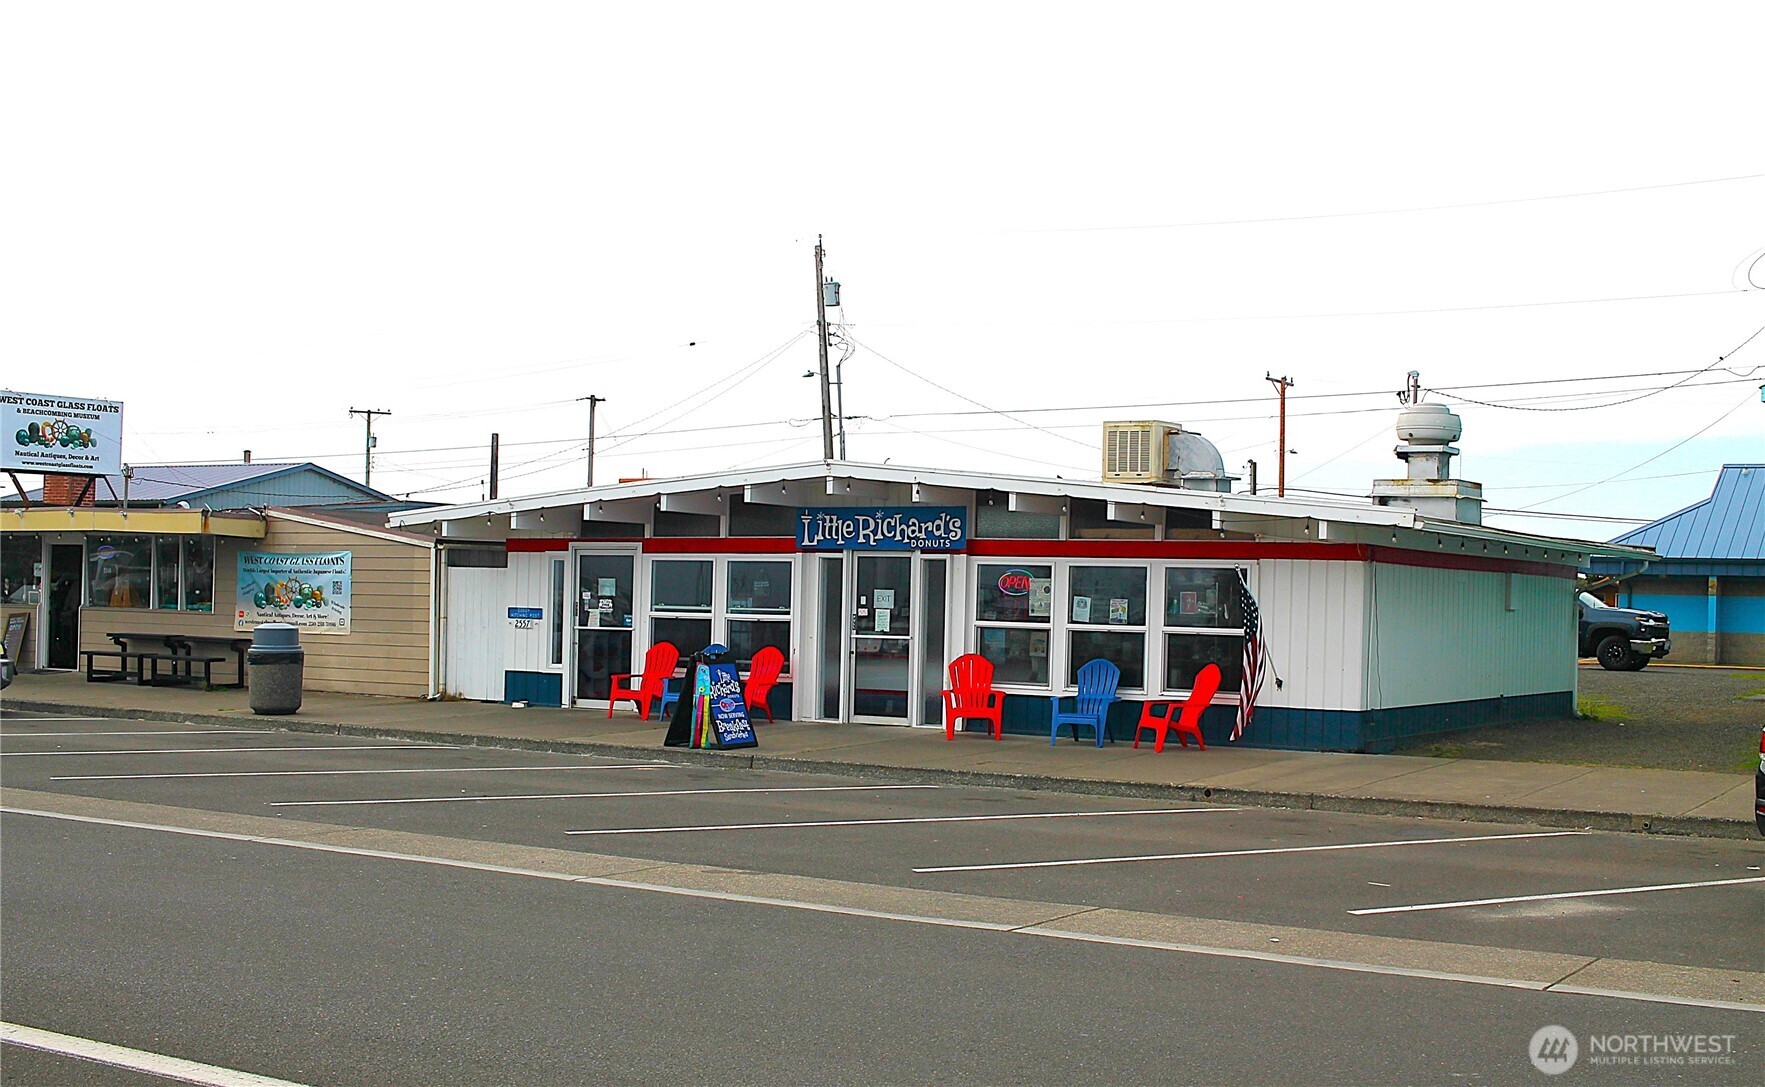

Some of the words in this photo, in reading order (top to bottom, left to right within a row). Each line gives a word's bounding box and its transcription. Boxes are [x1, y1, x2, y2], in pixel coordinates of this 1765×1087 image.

[0, 396, 24, 405] WEST
[26, 398, 55, 408] COAST
[57, 400, 86, 411] GLASS
[87, 403, 119, 413] FLOATS
[22, 408, 72, 418] BEACHCOMBING
[73, 412, 100, 420] MUSEUM
[40, 452, 67, 460] Antiques,
[801, 510, 855, 545] Little
[855, 510, 962, 545] Richard's
[910, 540, 951, 548] DONUTS
[244, 556, 265, 565] WEST
[264, 556, 289, 565] COAST
[289, 557, 318, 566] GLASS
[317, 556, 345, 565] FLOATS
[1000, 576, 1030, 590] OPEN
[515, 619, 531, 628] 2557
[716, 719, 750, 732] Breakfast
